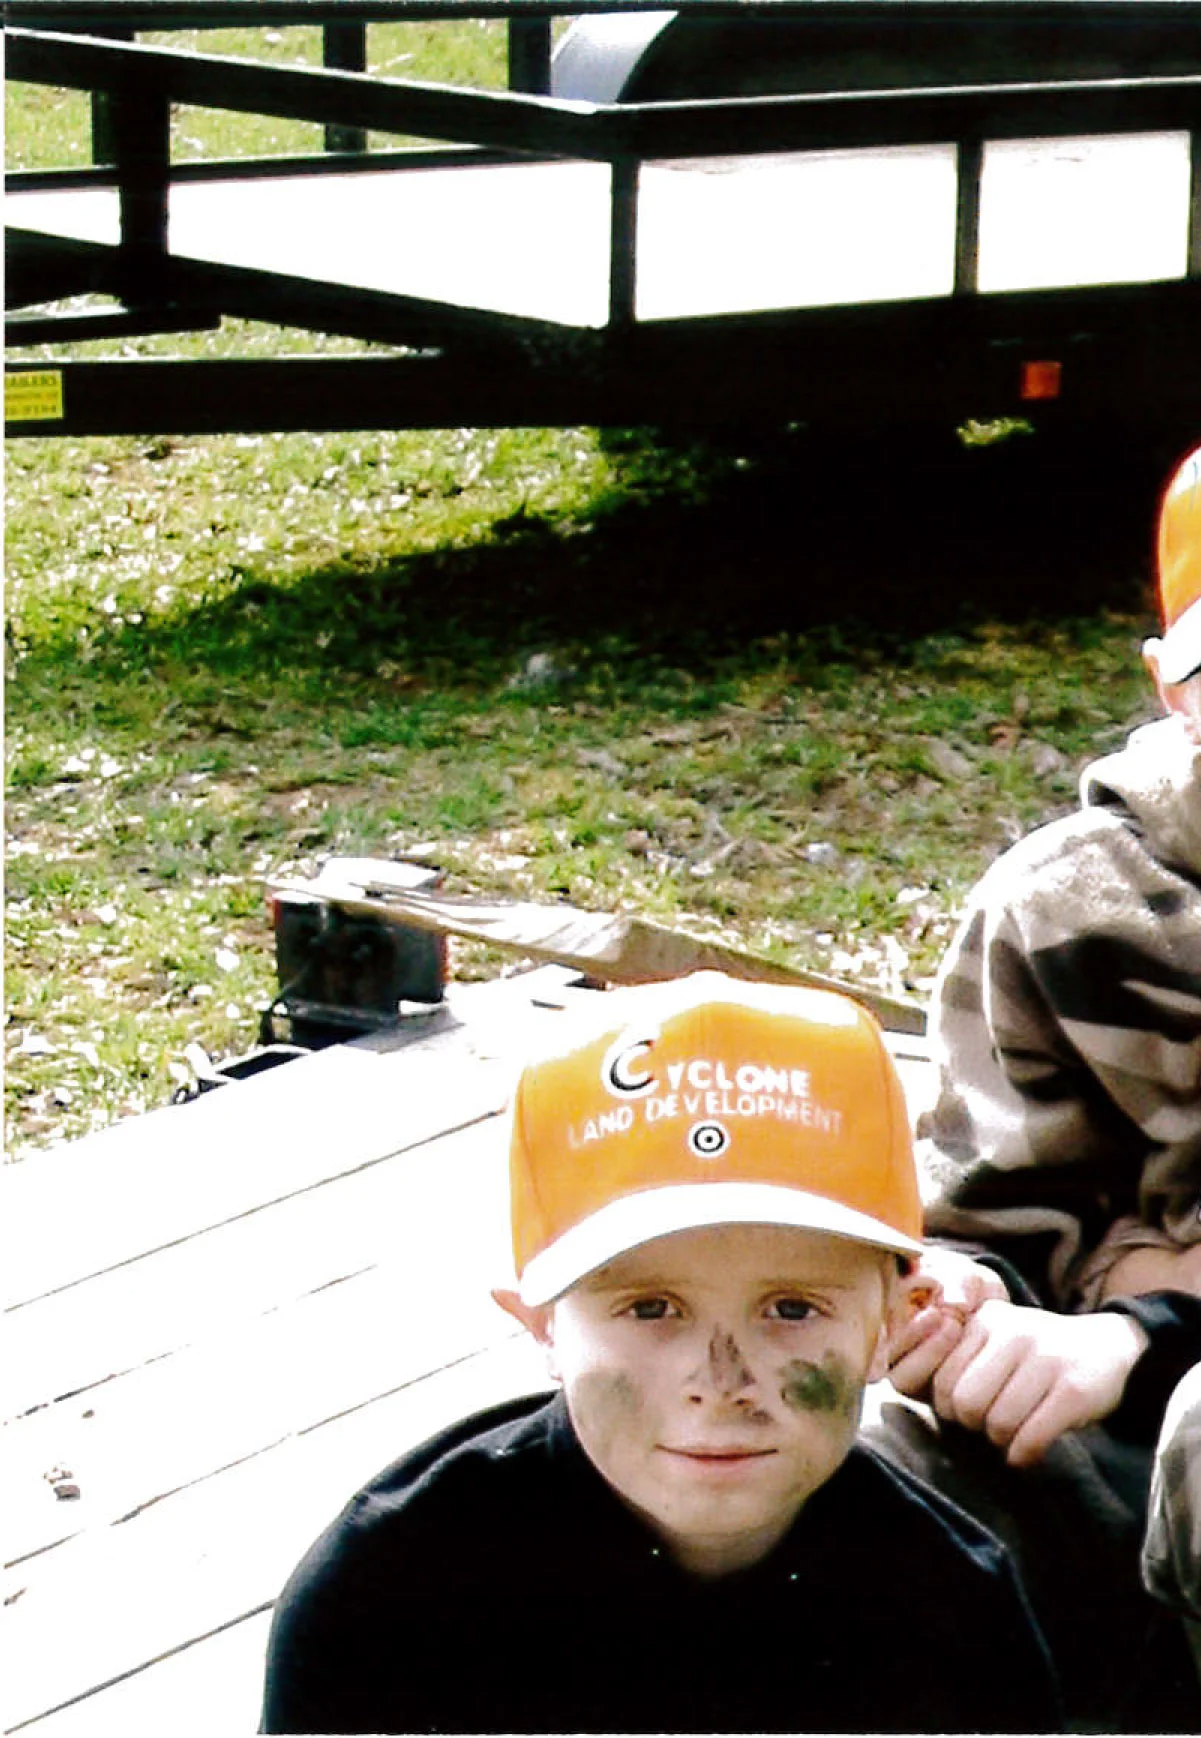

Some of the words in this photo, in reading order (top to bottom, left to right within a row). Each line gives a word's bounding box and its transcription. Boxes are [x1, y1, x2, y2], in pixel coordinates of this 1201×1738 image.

[601, 1037, 810, 1100] CYCLONE
[567, 1107, 634, 1147] LAND
[646, 1092, 842, 1133] DEVELOPMENT
